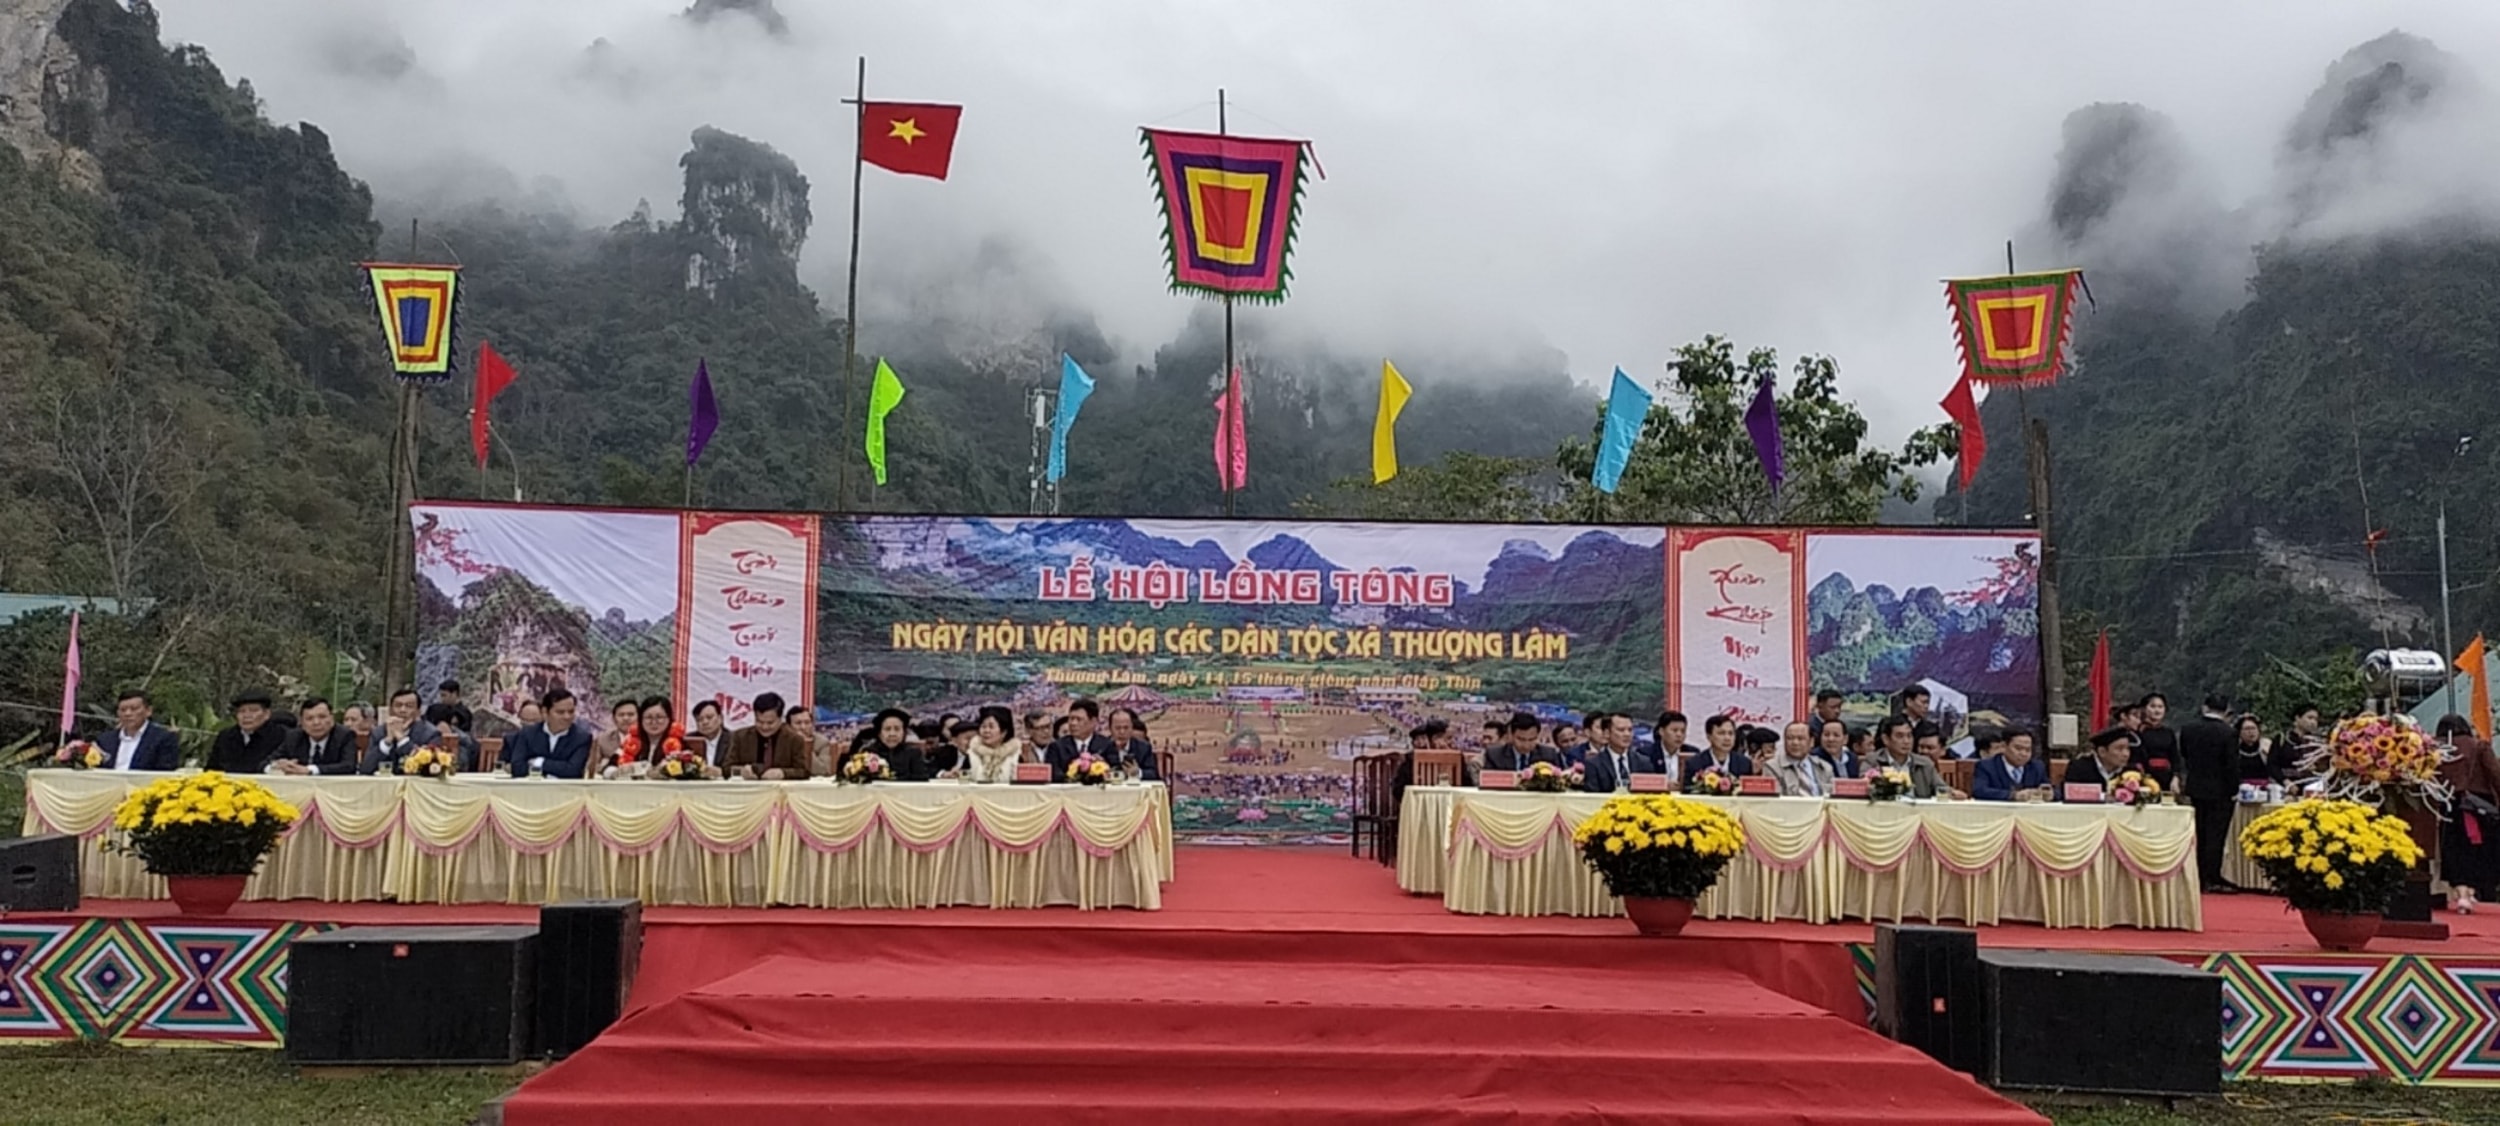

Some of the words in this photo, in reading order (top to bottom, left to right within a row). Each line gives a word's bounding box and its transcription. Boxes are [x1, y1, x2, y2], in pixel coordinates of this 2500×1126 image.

[1041, 555, 1094, 599] LỄ
[1105, 562, 1187, 608] HỘI
[1201, 558, 1319, 604] LỒNG
[1332, 565, 1452, 606] TÔNG
[893, 617, 969, 652] NGÀY
[975, 618, 1024, 656] HỘI
[1033, 619, 1089, 653] VĂN
[1098, 620, 1156, 655] HÓA
[1165, 621, 1215, 656] CÁC
[1221, 622, 1279, 657] DÂN
[1288, 623, 1339, 660] TỘC
[1346, 625, 1382, 658] XÃ
[1389, 628, 1504, 662] THƯỢNG
[1512, 627, 1568, 661] LÂM
